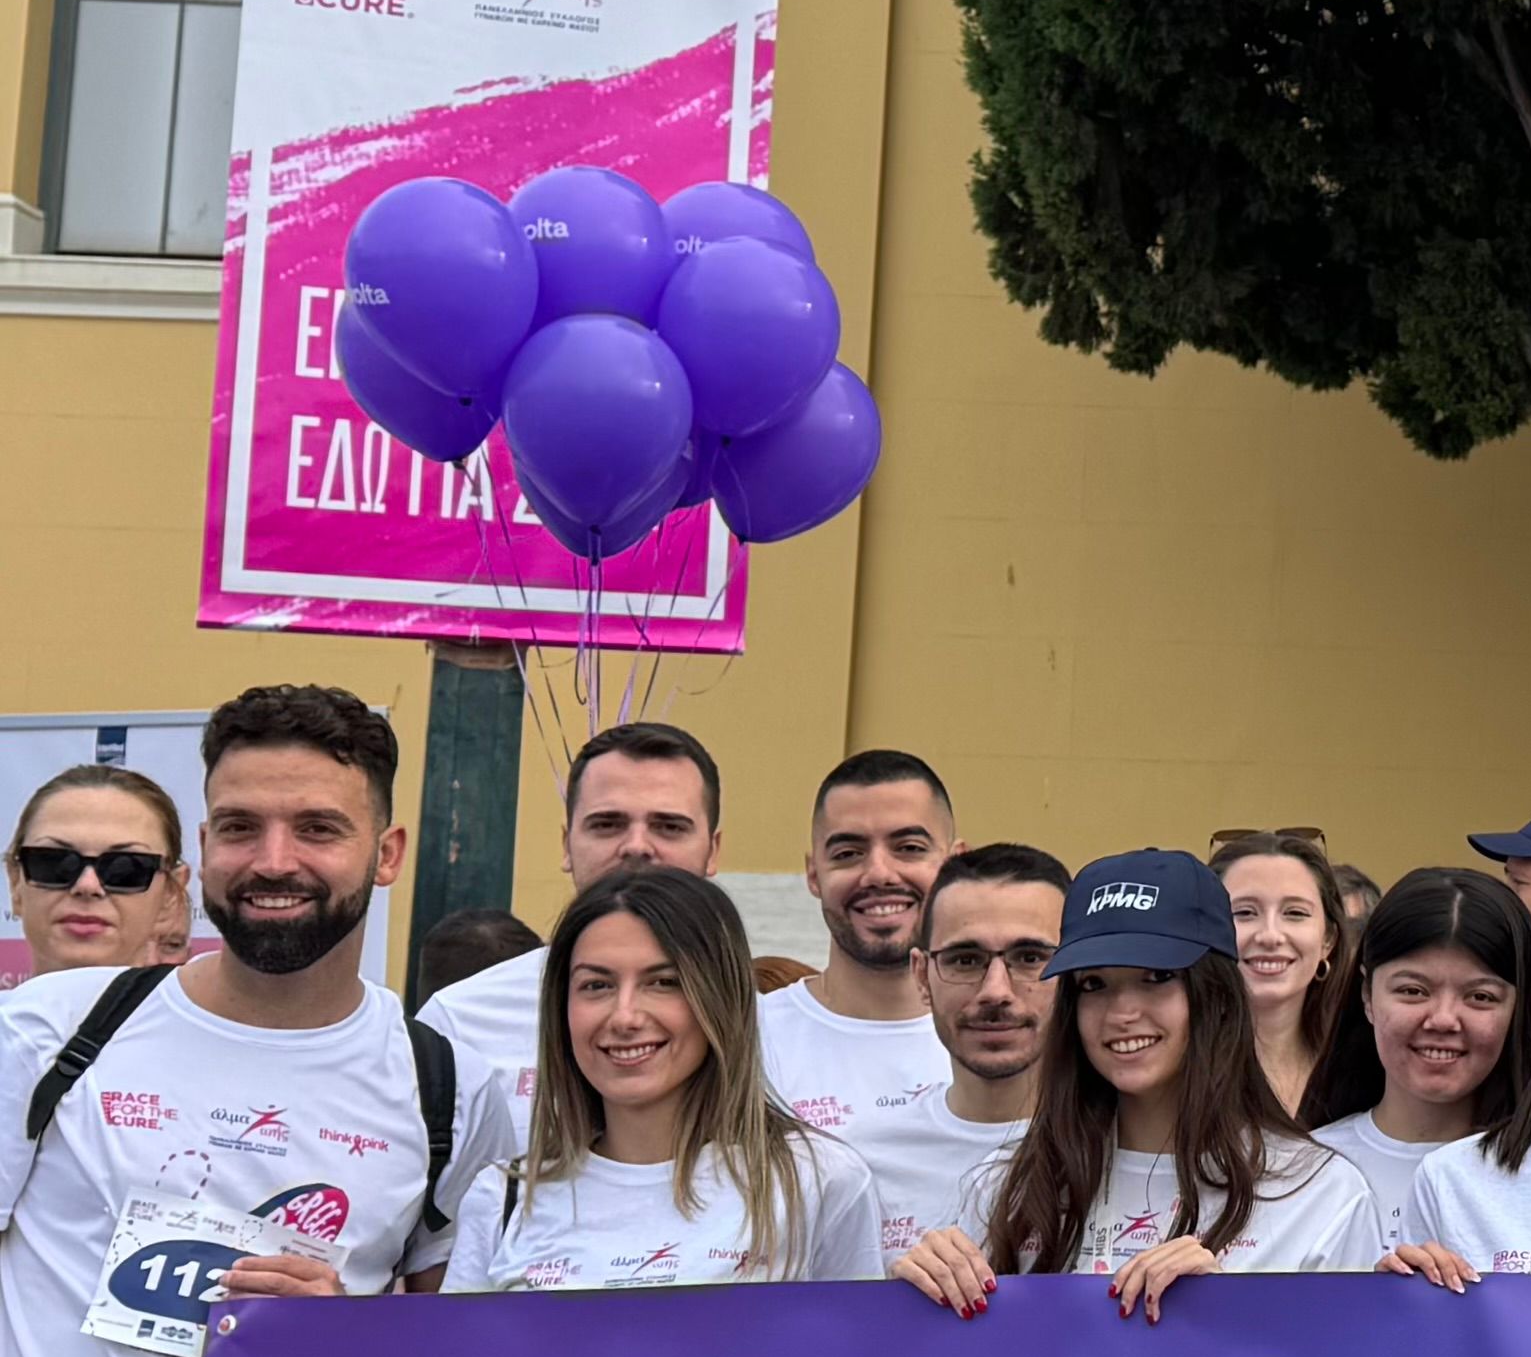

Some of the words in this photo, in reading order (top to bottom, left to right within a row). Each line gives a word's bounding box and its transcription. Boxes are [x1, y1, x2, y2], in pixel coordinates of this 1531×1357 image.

[524, 217, 569, 240] olta
[674, 235, 706, 254] olt
[351, 282, 390, 306] olta
[1086, 892, 1154, 916] KPMG
[111, 1091, 160, 1106] RACE
[112, 1103, 145, 1116] FOR
[319, 1128, 351, 1143] think
[361, 1138, 390, 1153] pink
